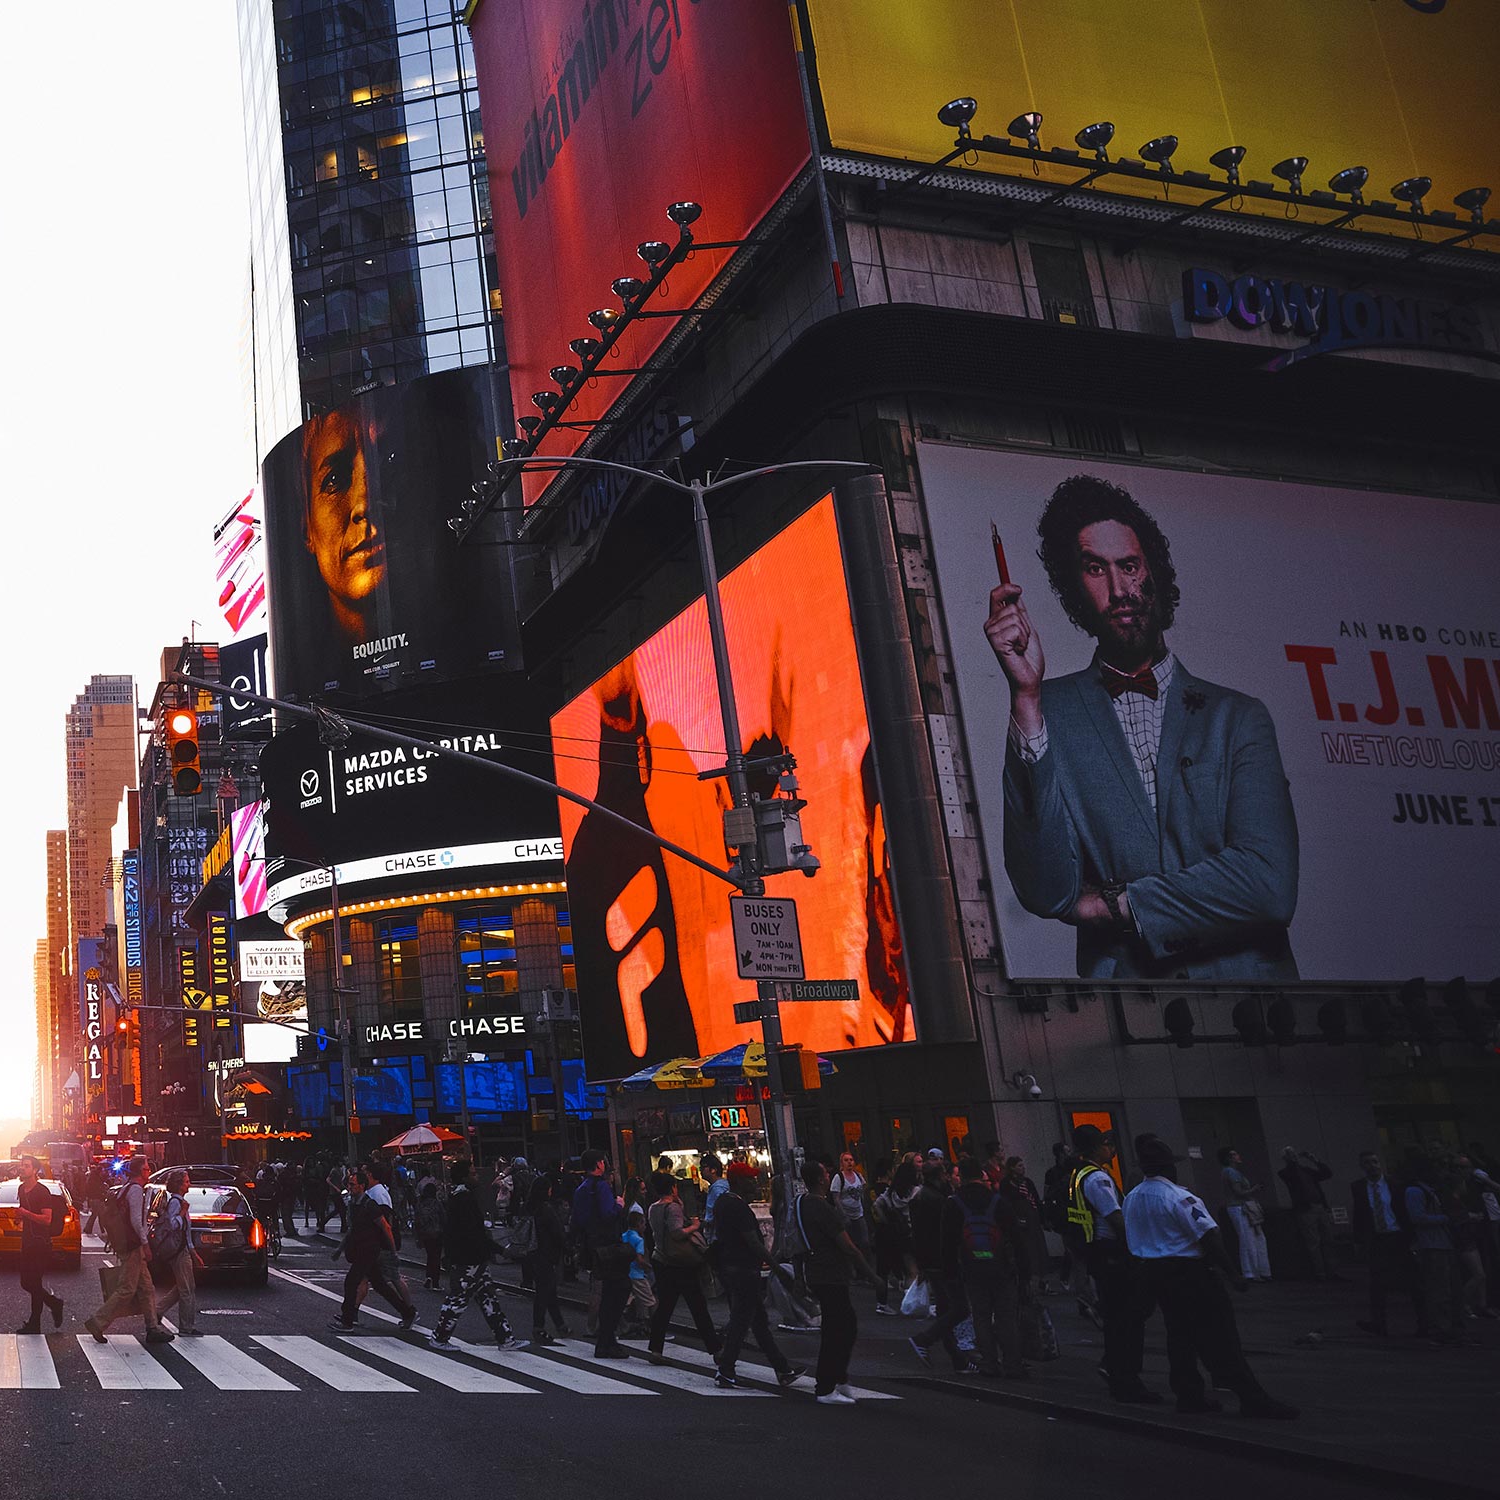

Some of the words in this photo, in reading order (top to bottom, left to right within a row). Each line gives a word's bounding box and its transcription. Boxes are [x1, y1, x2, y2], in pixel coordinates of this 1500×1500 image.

[1182, 267, 1326, 337] DOW
[1312, 286, 1484, 352] JONES
[1339, 620, 1368, 639] AN
[1377, 624, 1427, 643] HBO
[352, 632, 410, 660] EQUALITY.
[1284, 644, 1426, 726] T.J.
[344, 747, 407, 775] MAZDA
[345, 765, 429, 797] SERVICES
[300, 795, 323, 810] mazda
[1392, 793, 1474, 826] JUNE
[385, 853, 437, 873] CHASE
[124, 878, 139, 903] 42
[299, 871, 332, 890] CHASE
[744, 904, 784, 919] BUSES
[751, 922, 781, 936] ONLY
[126, 919, 141, 968] STUDIOS
[211, 914, 228, 985] VICTORY
[249, 955, 302, 967] WORK
[755, 963, 773, 972] MON
[788, 964, 800, 973] FRI
[128, 972, 142, 1001] DUKE
[795, 983, 855, 999] Broadway
[215, 994, 230, 1028] NW
[87, 983, 102, 1079] REGAL
[185, 1017, 198, 1047] NEW
[365, 1021, 424, 1043] CHASE
[449, 1015, 527, 1038] CHASE
[207, 1057, 245, 1072] SKCHERS
[710, 1107, 750, 1128] SODA
